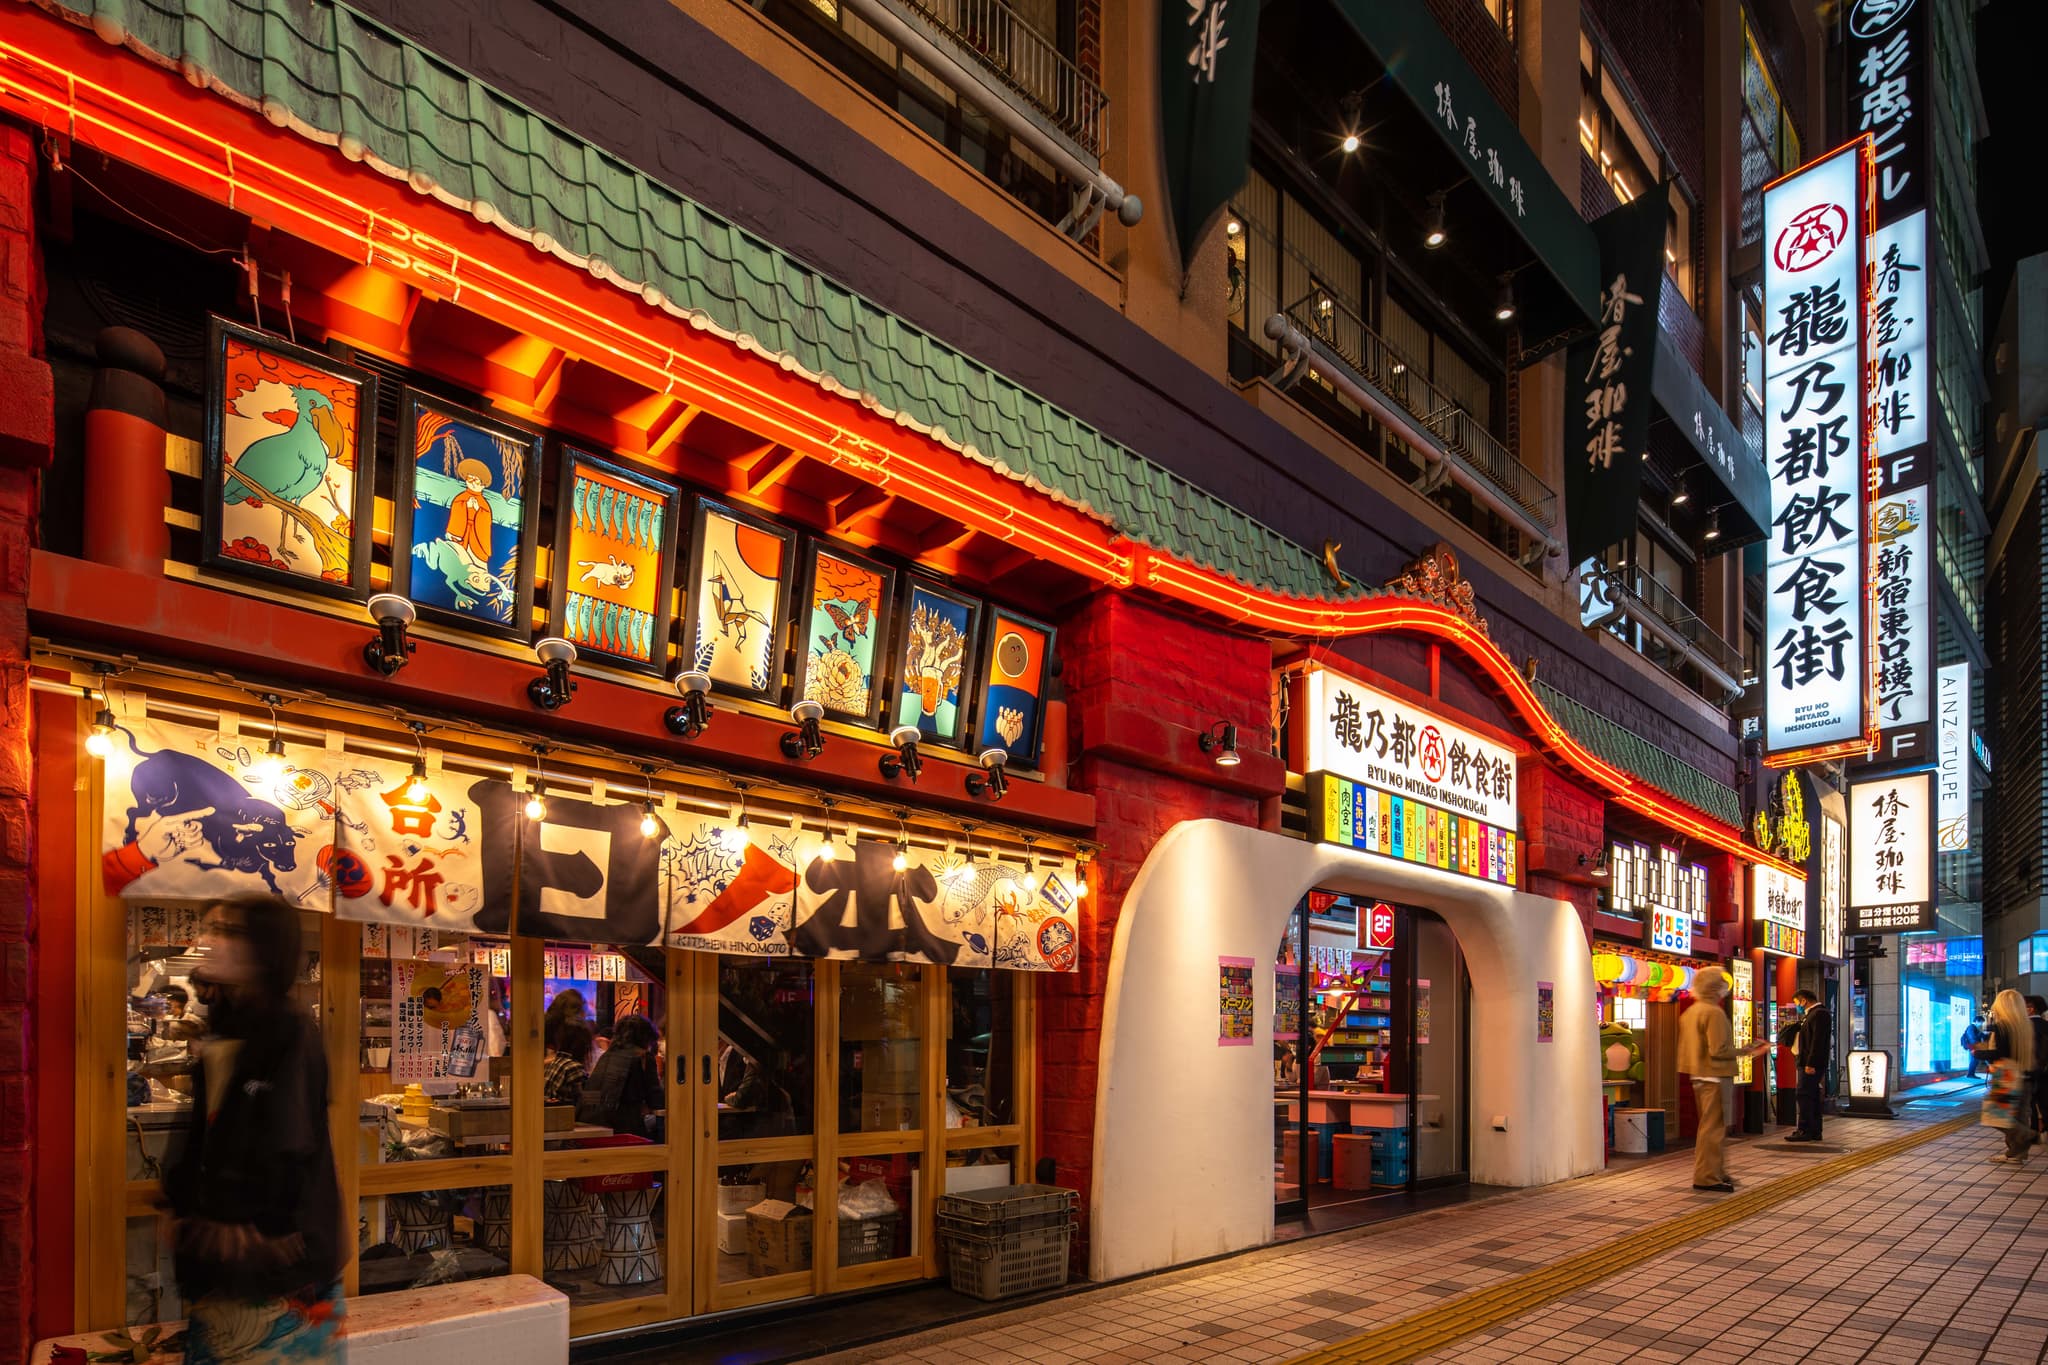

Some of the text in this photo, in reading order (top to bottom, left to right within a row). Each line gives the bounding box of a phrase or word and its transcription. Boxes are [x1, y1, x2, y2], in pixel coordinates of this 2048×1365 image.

[1434, 81, 1525, 216] 椿屋珈琲
[1767, 278, 1853, 690] 龍乃都飲食街
[1784, 717, 1841, 734] INSHOKUGAI
[1794, 701, 1829, 714] RYU NO
[1795, 711, 1829, 723] MIYAKO
[1942, 677, 1958, 729] AINZ
[1330, 689, 1513, 805] 龍乃都 飲食街
[1367, 764, 1487, 816] RYU NO MIYAKO INSHOKUGAI
[1942, 750, 1958, 801] TULPE
[1872, 788, 1909, 895] 椿屋珈琲
[730, 941, 786, 954] HINOMOTO
[1374, 914, 1392, 933] 2F
[1861, 1055, 1874, 1094] 椿屋珈琲
